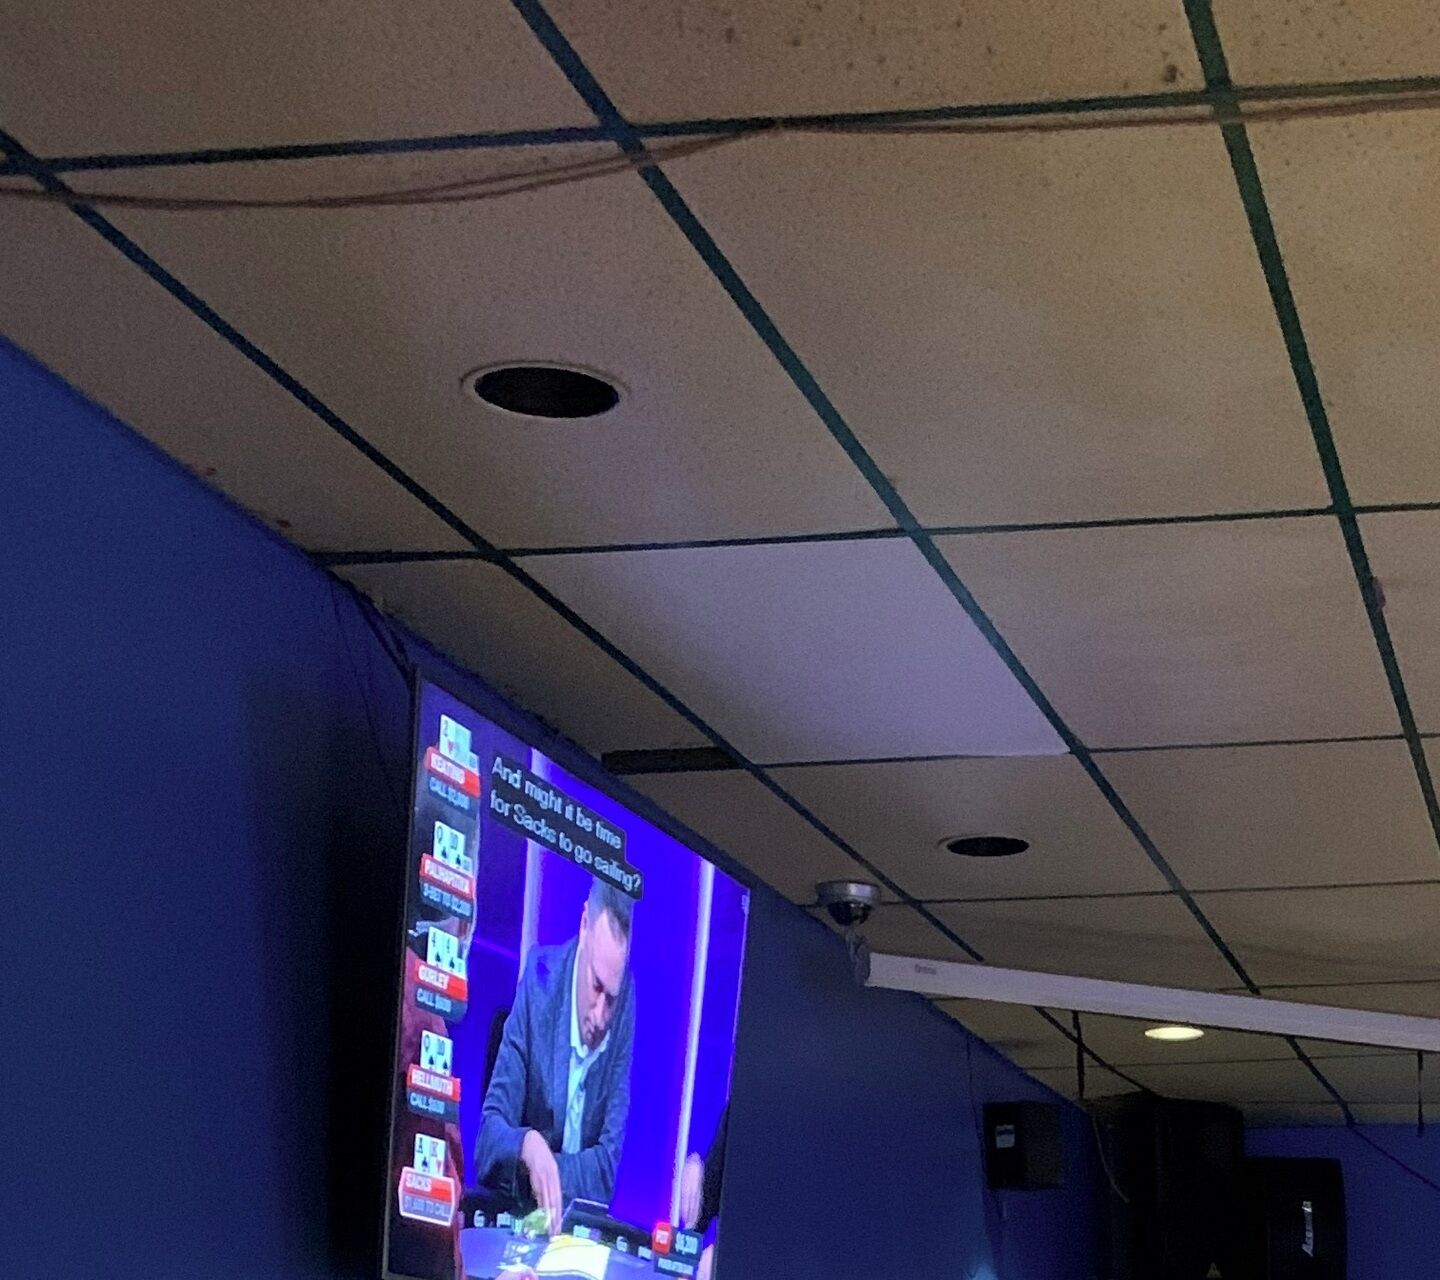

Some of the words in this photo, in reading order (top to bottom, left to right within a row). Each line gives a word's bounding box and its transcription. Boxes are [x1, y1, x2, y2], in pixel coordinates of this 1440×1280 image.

[492, 757, 522, 789] And
[525, 780, 562, 815] might
[565, 804, 574, 822] it
[576, 807, 593, 832] be
[595, 821, 622, 849] time
[490, 789, 511, 817] for
[513, 803, 557, 843] Sacks
[559, 832, 573, 852] to
[574, 846, 593, 864] go
[594, 856, 641, 892] sailing?
[417, 988, 435, 1007] CALL
[410, 1092, 428, 1110] CALL
